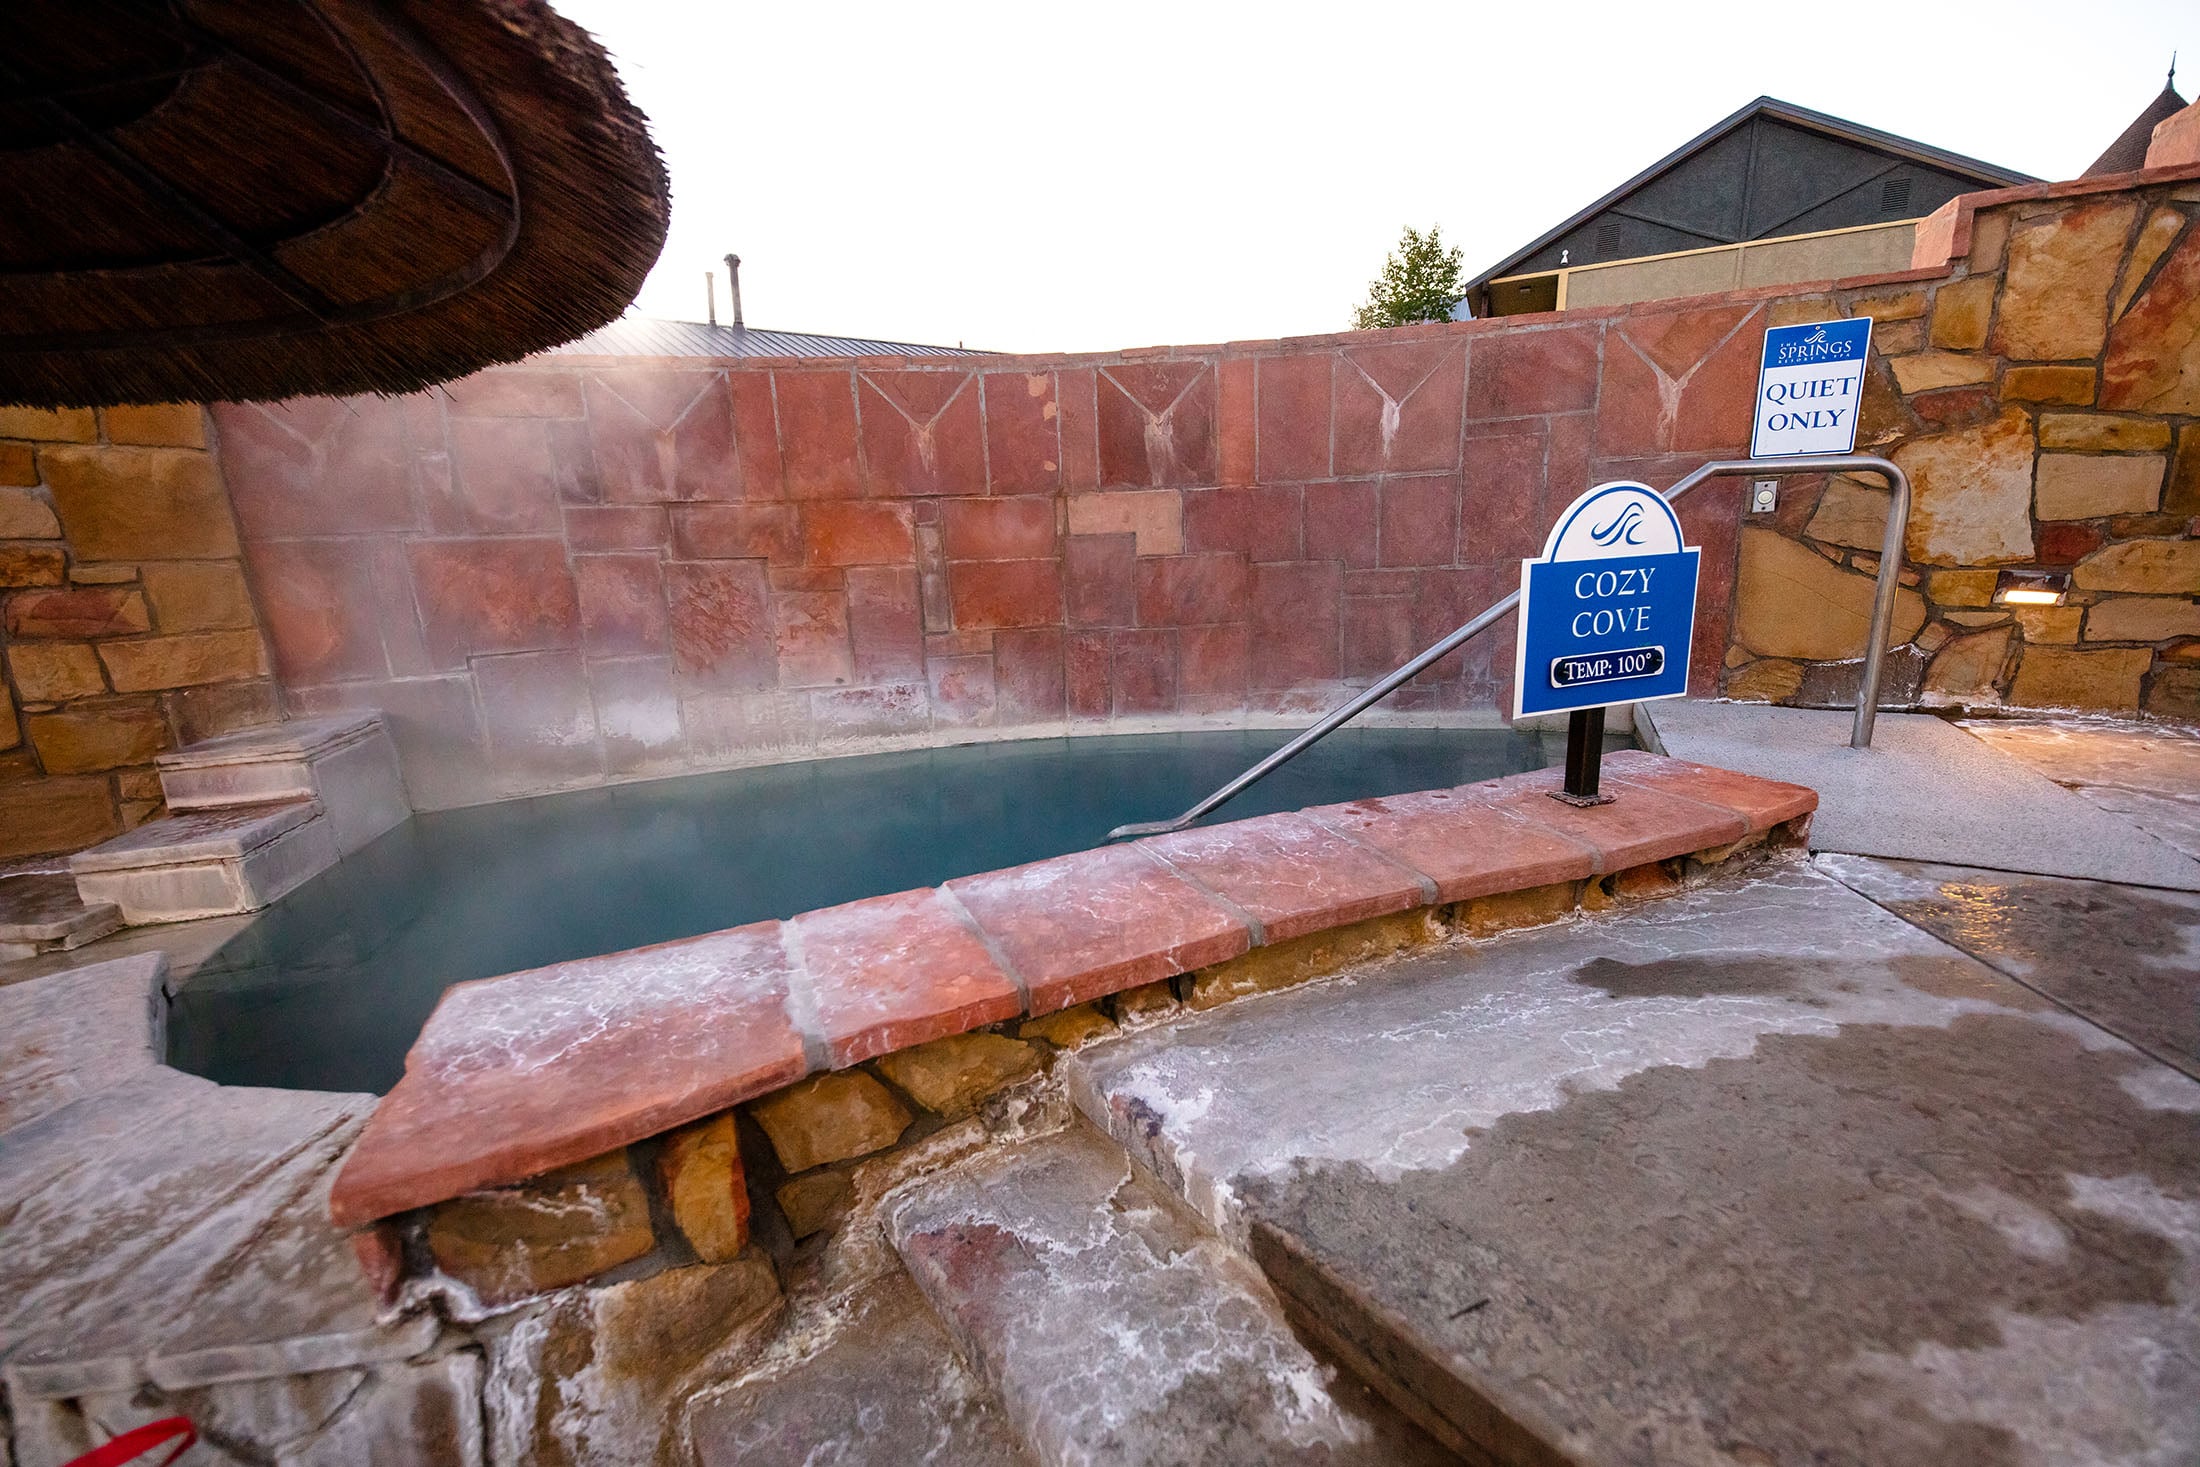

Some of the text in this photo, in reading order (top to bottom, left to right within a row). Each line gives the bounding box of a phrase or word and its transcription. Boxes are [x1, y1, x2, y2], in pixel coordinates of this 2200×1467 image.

[1778, 340, 1852, 360] SPRINGS
[1766, 377, 1857, 406] QUIET
[1767, 409, 1846, 432] ONLY
[1574, 567, 1656, 600] COZY
[1572, 605, 1652, 639] COVE
[1564, 652, 1653, 682] TEMP: 100°
